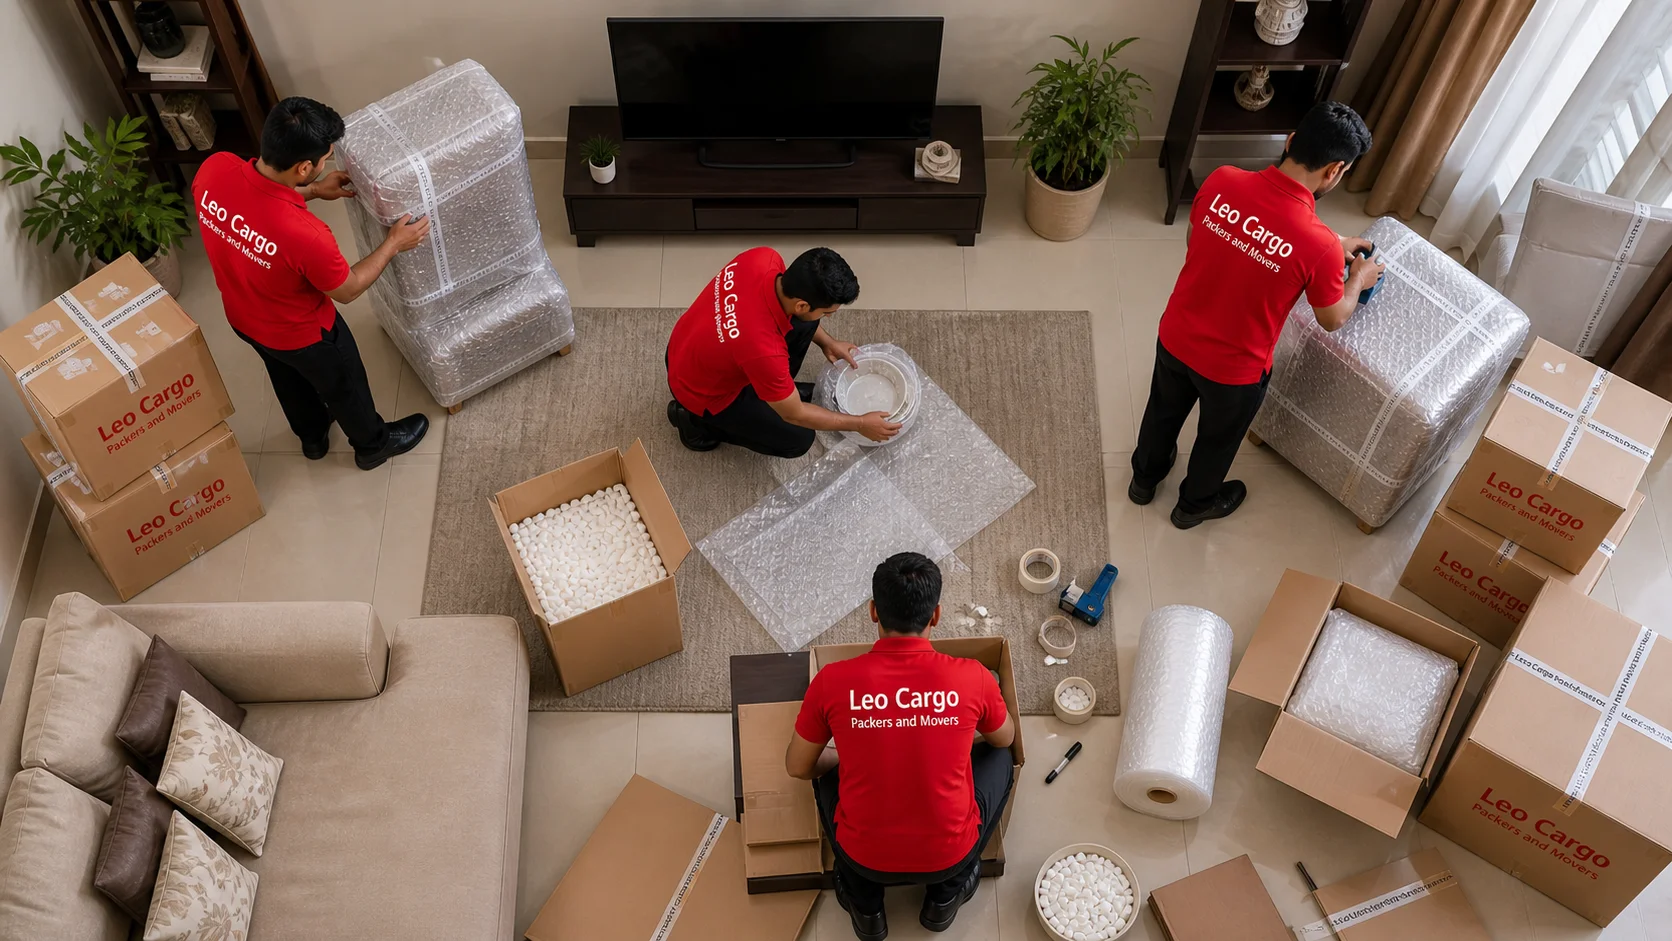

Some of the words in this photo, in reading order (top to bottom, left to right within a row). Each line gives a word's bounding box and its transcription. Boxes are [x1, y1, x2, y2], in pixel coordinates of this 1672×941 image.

[200, 190, 228, 222] Leo
[230, 214, 278, 256] Cargo
[226, 235, 242, 250] and
[241, 245, 272, 270] Movers
[1202, 215, 1232, 242] Packers
[1231, 237, 1250, 253] and
[1247, 246, 1281, 273] Movers
[1208, 193, 1240, 224] Leo
[1242, 216, 1293, 258] Cargo
[723, 262, 738, 291] Leo
[723, 293, 740, 339] Cargo
[97, 412, 137, 442] Leo
[139, 373, 195, 414] Cargo
[106, 426, 146, 454] Packers
[147, 412, 165, 430] and
[166, 389, 202, 416] Movers
[126, 515, 166, 543] Leo
[169, 478, 225, 517] Cargo
[135, 528, 173, 555] Packers
[175, 514, 194, 532] and
[195, 494, 232, 520] Movers
[1479, 487, 1517, 512] Packers
[1517, 508, 1538, 522] and
[1538, 518, 1575, 542] Movers
[1486, 471, 1523, 499] Leo
[1527, 493, 1584, 531] Cargo
[1433, 565, 1468, 592] Packers
[1468, 589, 1488, 603] and
[1438, 550, 1474, 579] Leo
[1477, 575, 1529, 614] Cargo
[849, 689, 888, 711] Leo
[895, 687, 960, 713] Cargo
[851, 716, 893, 729] Packers
[895, 714, 917, 728] and
[920, 715, 959, 727] Movers
[1472, 803, 1522, 836] Packers
[1522, 833, 1550, 851] and
[1549, 848, 1599, 880] Movers
[1479, 787, 1529, 822] Leo
[1534, 818, 1611, 868] Cargo
